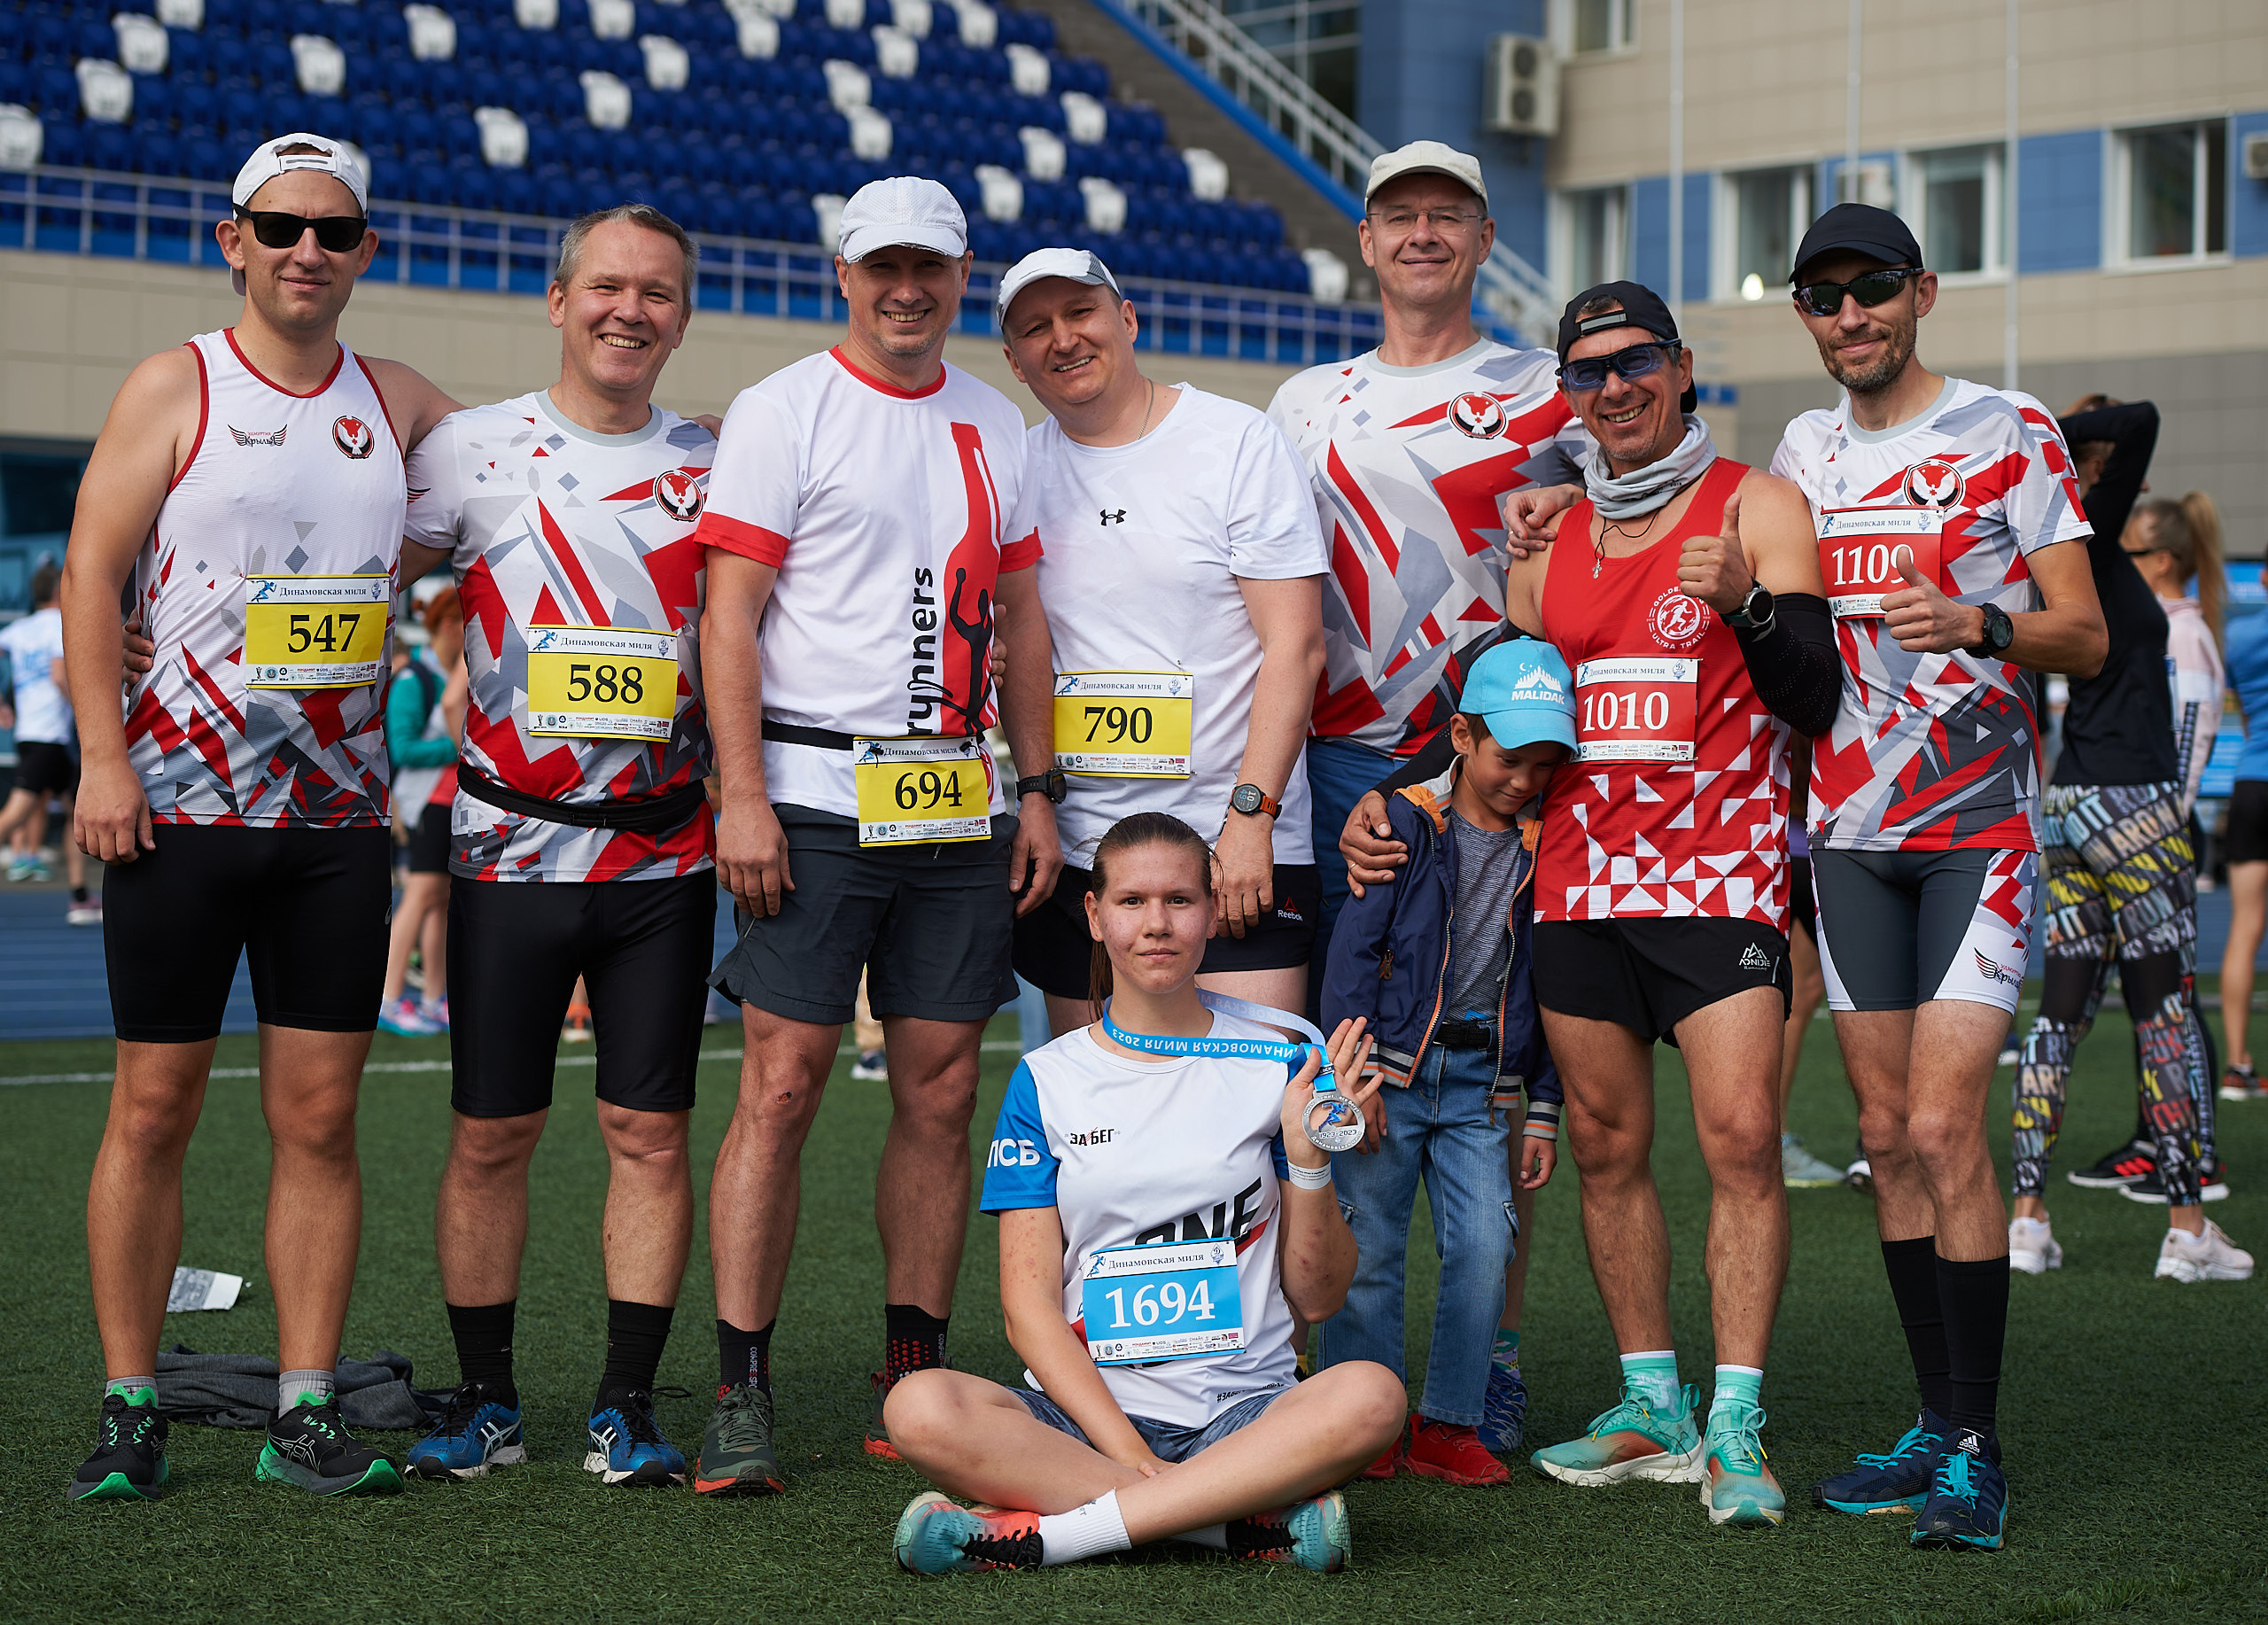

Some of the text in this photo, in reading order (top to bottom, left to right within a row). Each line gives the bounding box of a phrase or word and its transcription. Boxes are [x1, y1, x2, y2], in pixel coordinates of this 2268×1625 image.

[1837, 520, 1885, 530] Динамовская
[1831, 543, 1915, 586] 1109
[280, 587, 342, 597] Динамовская
[1653, 586, 1682, 607] GOLDE
[287, 613, 361, 653] 547
[1652, 632, 1705, 649] ULTRA TRAIL
[560, 637, 653, 650] Динамовская миля
[1588, 668, 1637, 677] Динамовская
[567, 664, 644, 704] 588
[1080, 681, 1135, 691] Динамовская
[1511, 689, 1565, 705] MALIDAK
[1582, 691, 1669, 732] 1010
[1084, 706, 1153, 743] 790
[883, 747, 939, 758] Динамовская
[895, 770, 963, 810] 694
[1278, 909, 1303, 921] Reebok
[1112, 1029, 1297, 1059] ИНАМОВСКАЯ МИЛЯ 2023
[1108, 1254, 1205, 1270] Динамовская миля
[1105, 1279, 1216, 1329] 1694
[1959, 1441, 1980, 1453] adidas
